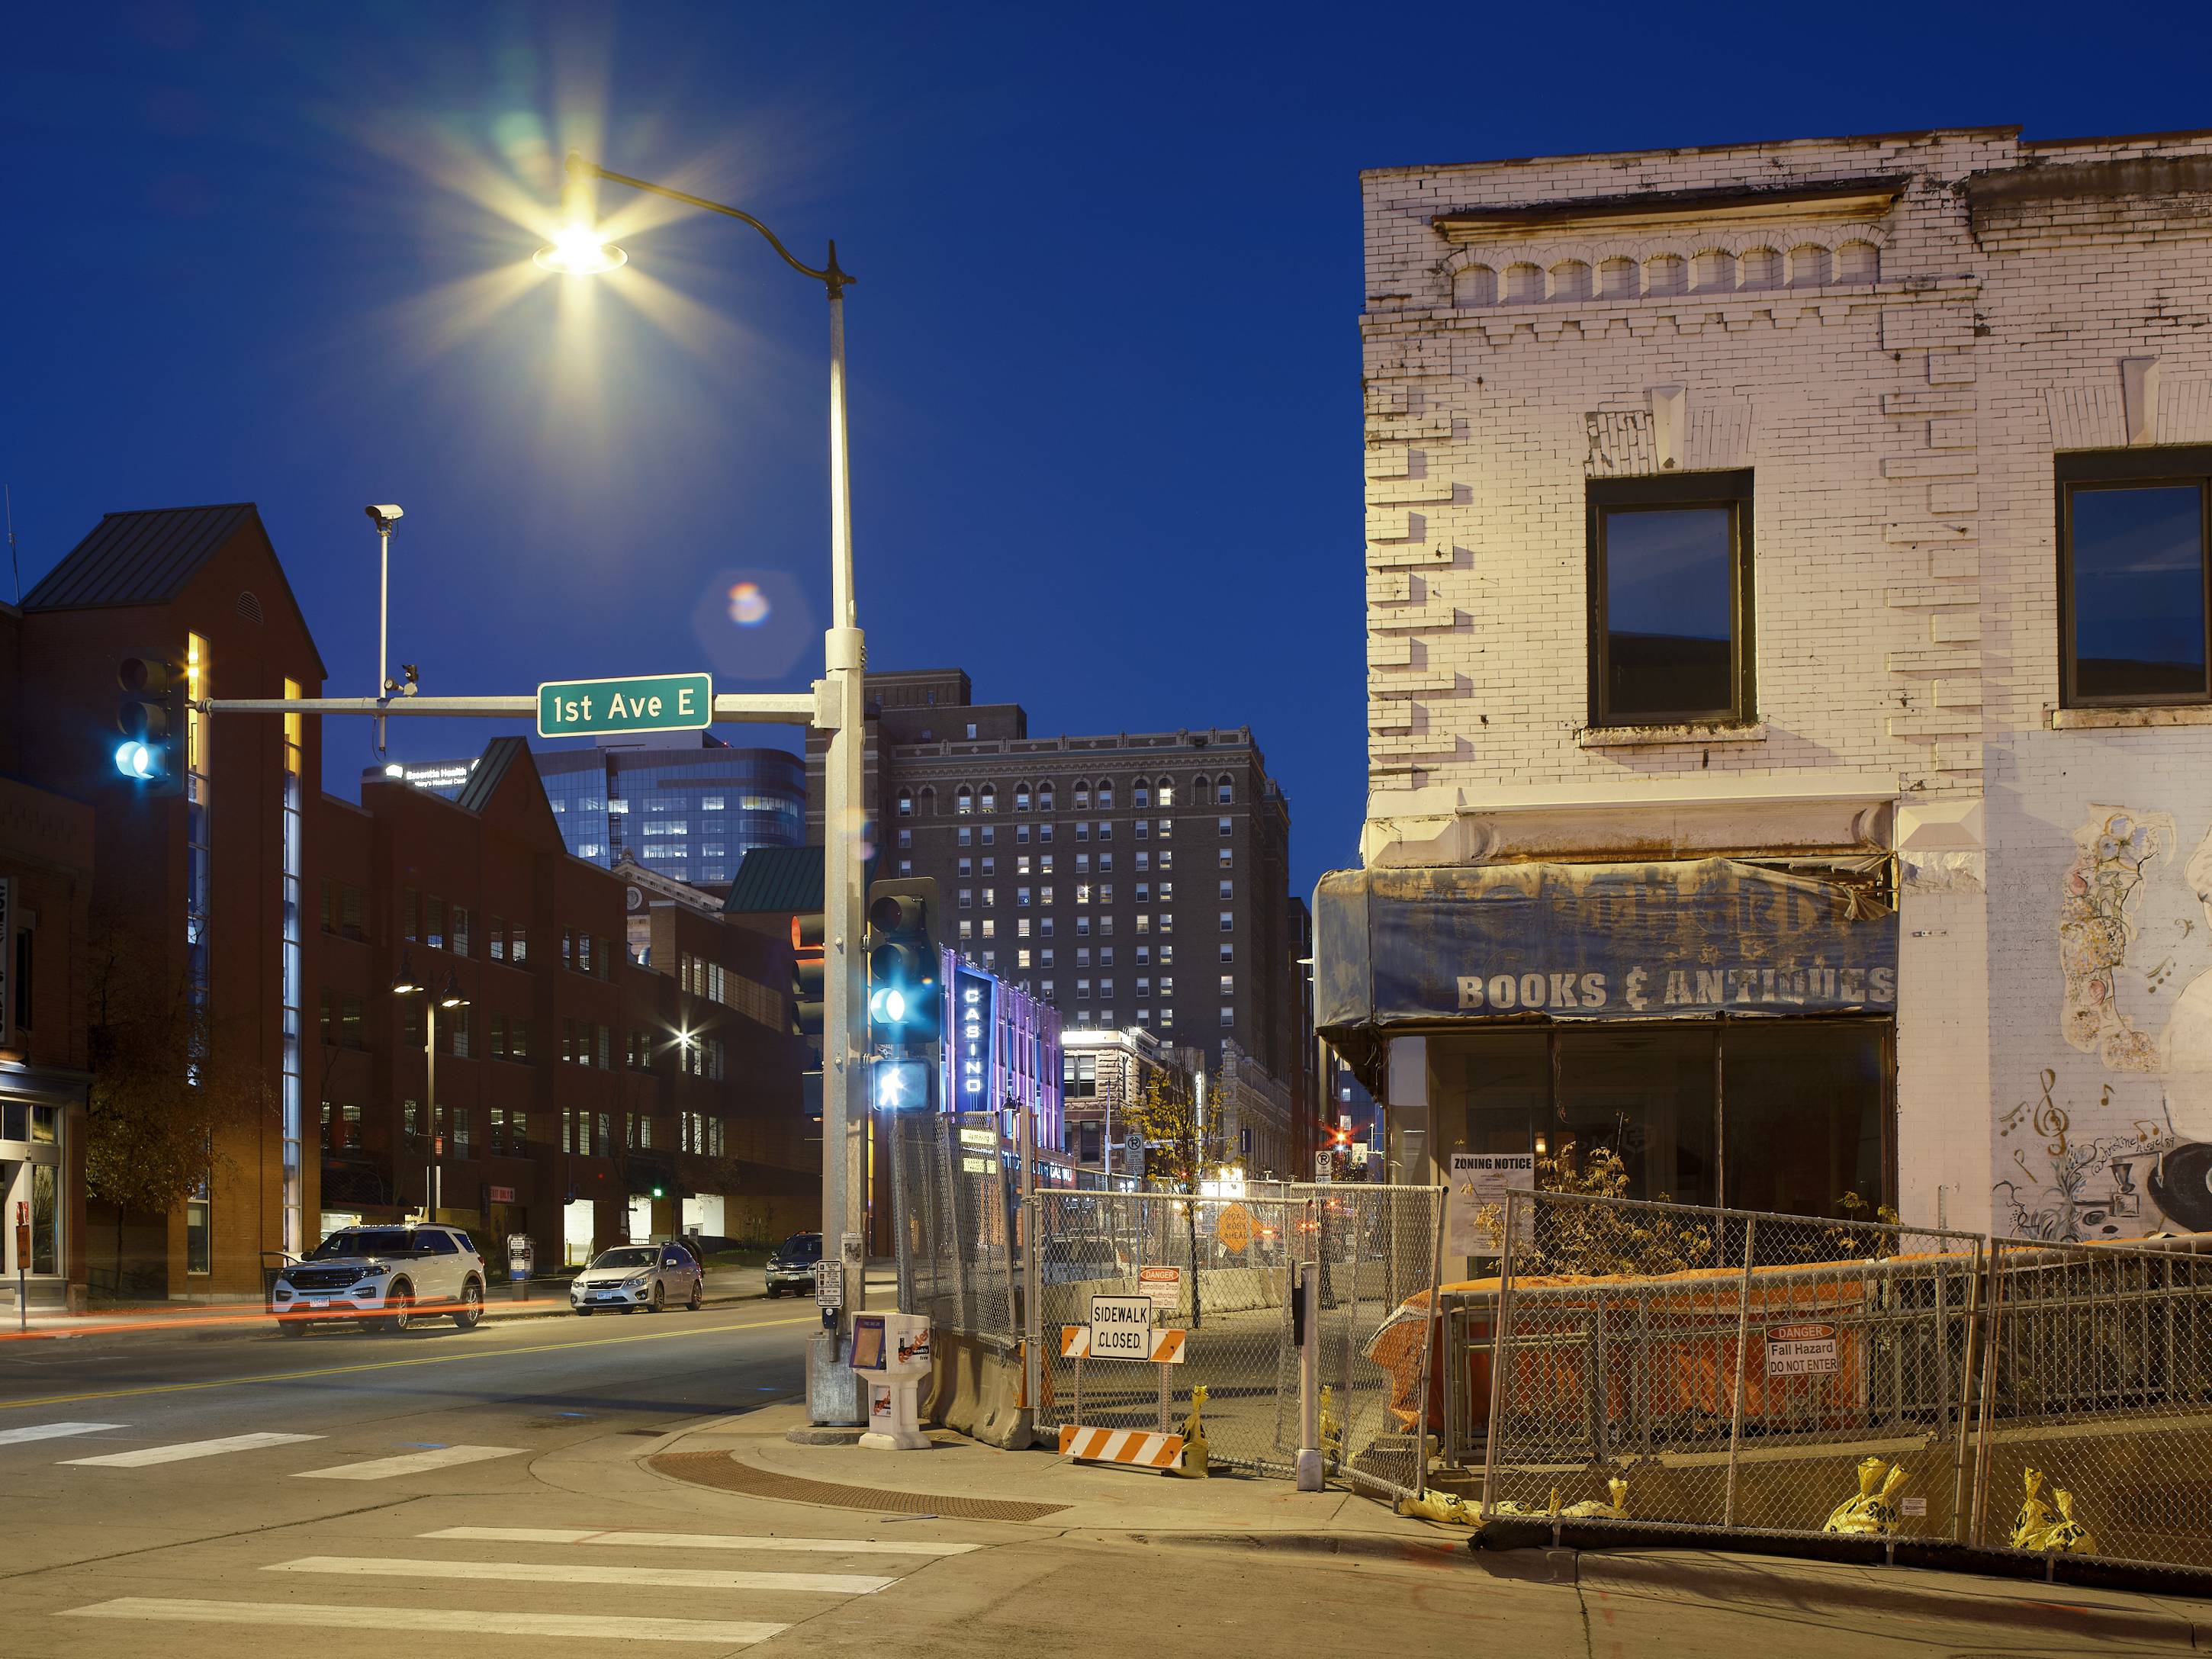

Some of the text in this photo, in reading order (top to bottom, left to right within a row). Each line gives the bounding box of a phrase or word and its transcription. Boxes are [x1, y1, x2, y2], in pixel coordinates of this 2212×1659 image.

[555, 688, 695, 722] 1st Ave E
[1456, 966, 1895, 1011] BOOKS & ANTIQUES
[965, 989, 981, 1093] CASINO
[1454, 1158, 1532, 1169] ZONING NOTICE
[1146, 1271, 1174, 1279] DANGER
[1094, 1306, 1147, 1323] SIDEWALK
[1778, 1326, 1824, 1338] DANGER
[1099, 1332, 1140, 1349] CLOSED
[1771, 1342, 1834, 1356] Fall Hazard
[1770, 1358, 1837, 1372] DO NOT ENTER
